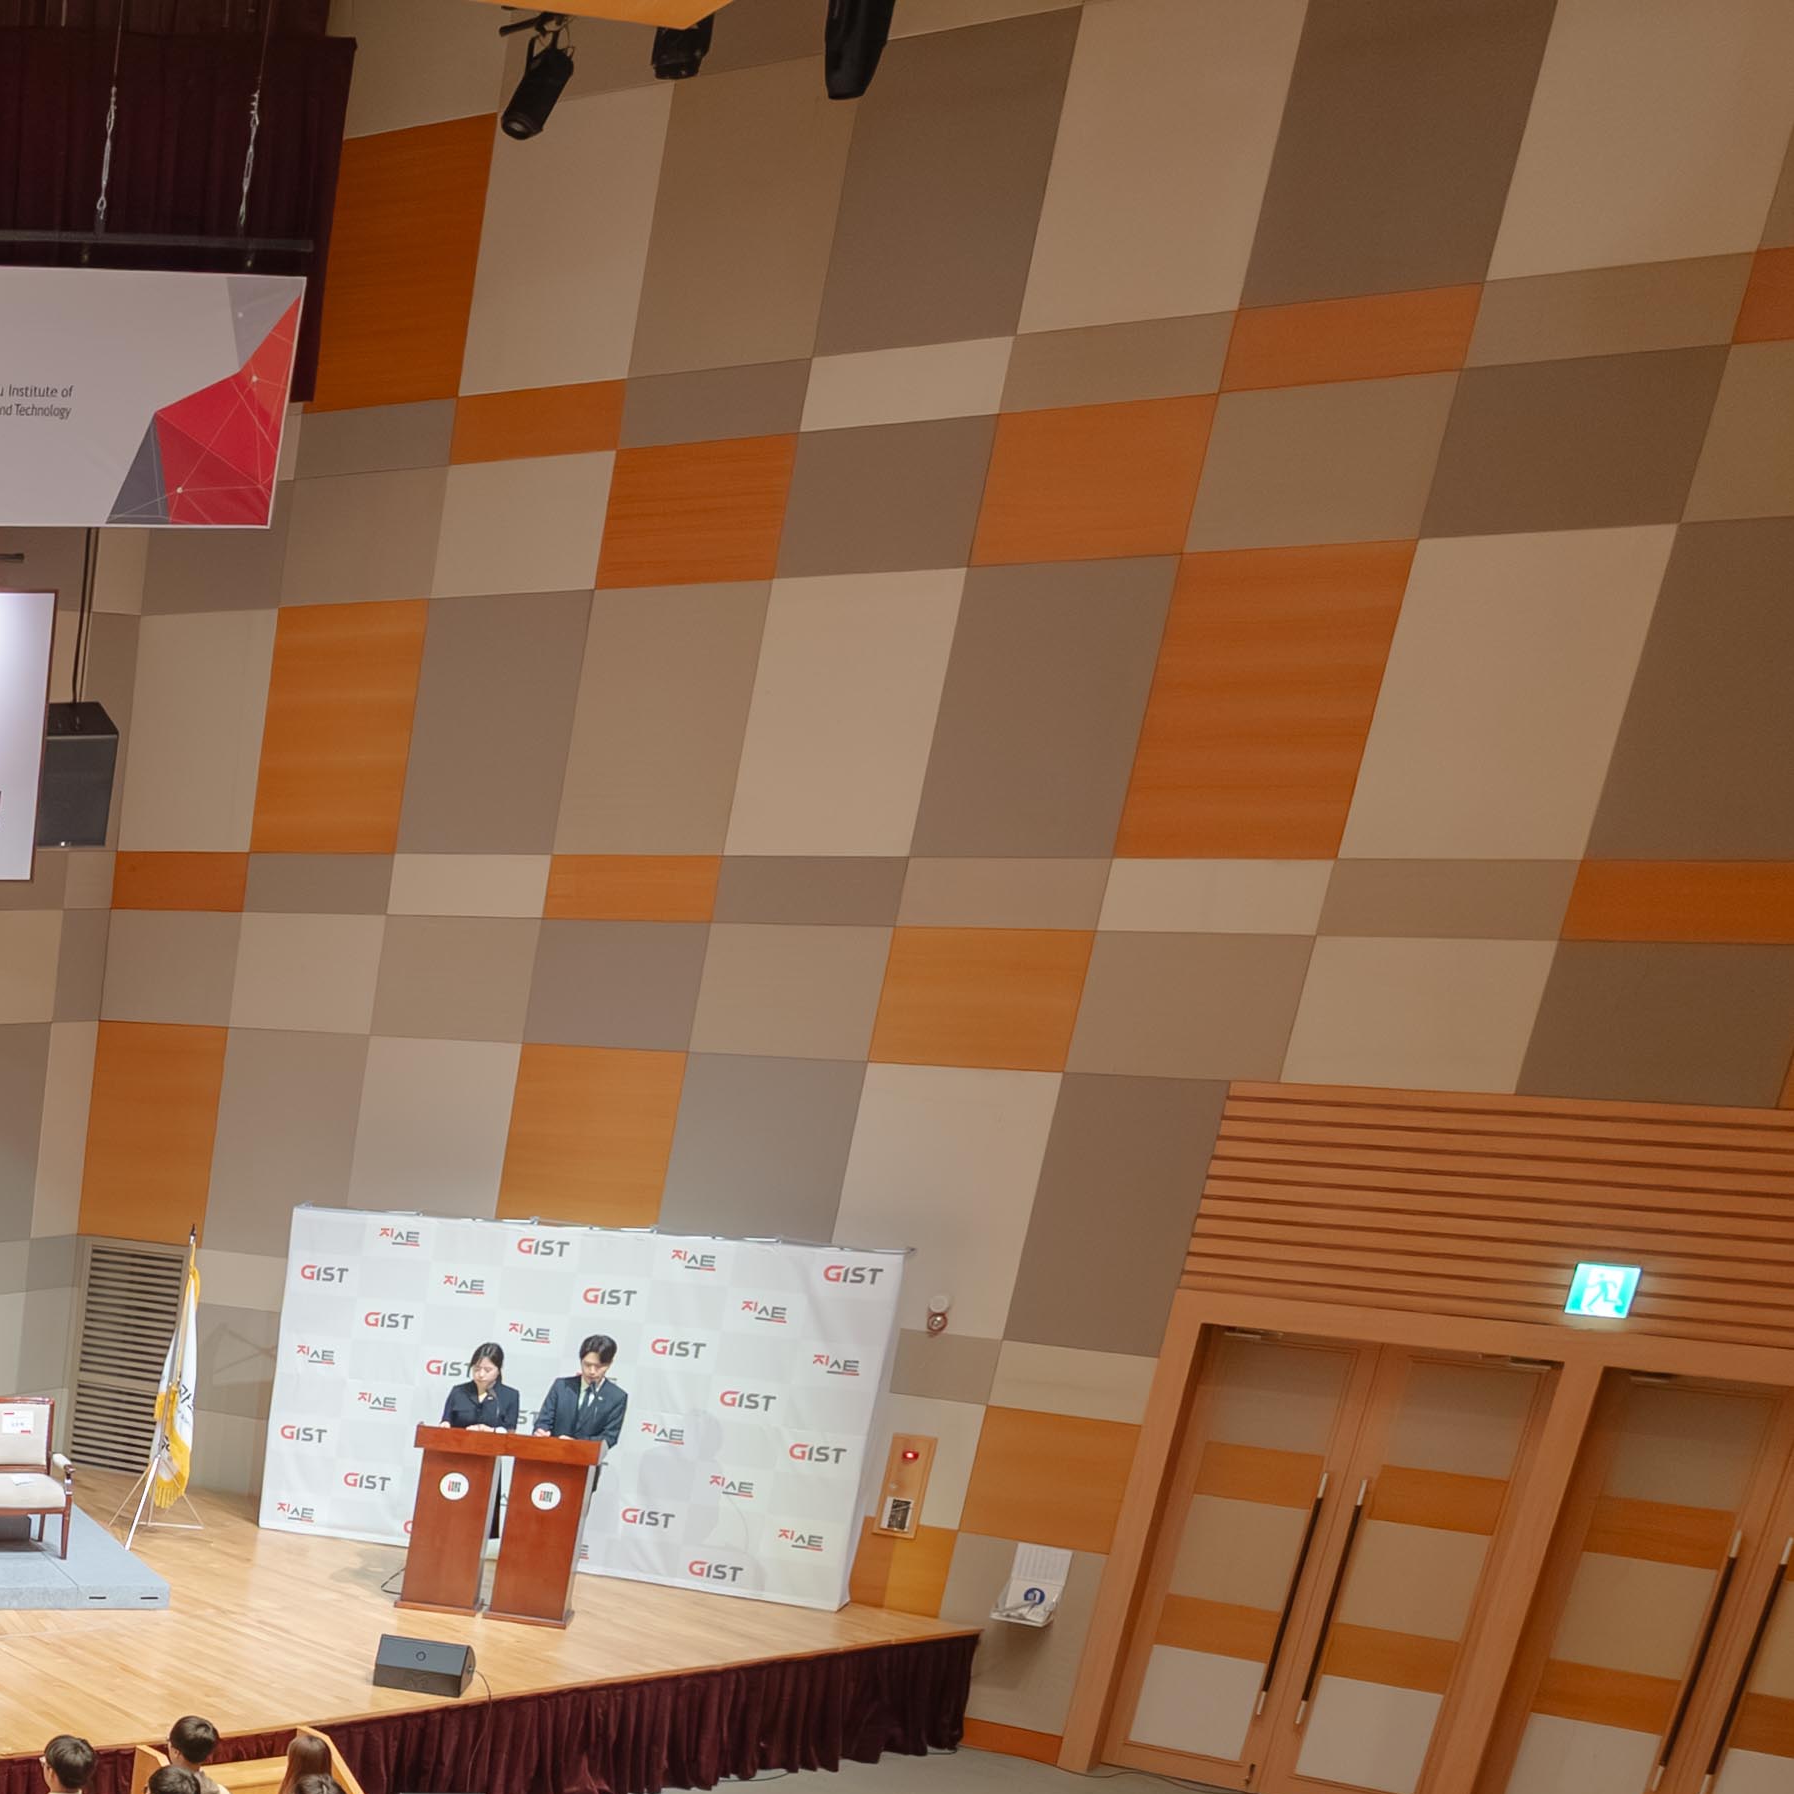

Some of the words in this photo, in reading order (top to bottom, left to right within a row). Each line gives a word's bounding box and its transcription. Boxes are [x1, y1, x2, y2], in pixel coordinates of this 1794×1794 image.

[8, 384, 58, 398] Institute
[60, 385, 74, 398] of
[14, 404, 71, 420] Technology
[517, 1237, 570, 1257] GIST
[301, 1264, 349, 1283] GIST
[823, 1264, 884, 1285] GIST
[582, 1287, 637, 1306] GIST
[364, 1311, 414, 1330] GIST
[651, 1338, 707, 1359] GIST
[719, 1390, 777, 1412] GIST
[280, 1424, 328, 1443] GIST
[788, 1443, 847, 1464] GIST
[343, 1472, 391, 1492] GIST
[621, 1508, 675, 1528] GIST
[688, 1560, 744, 1582] GIST
